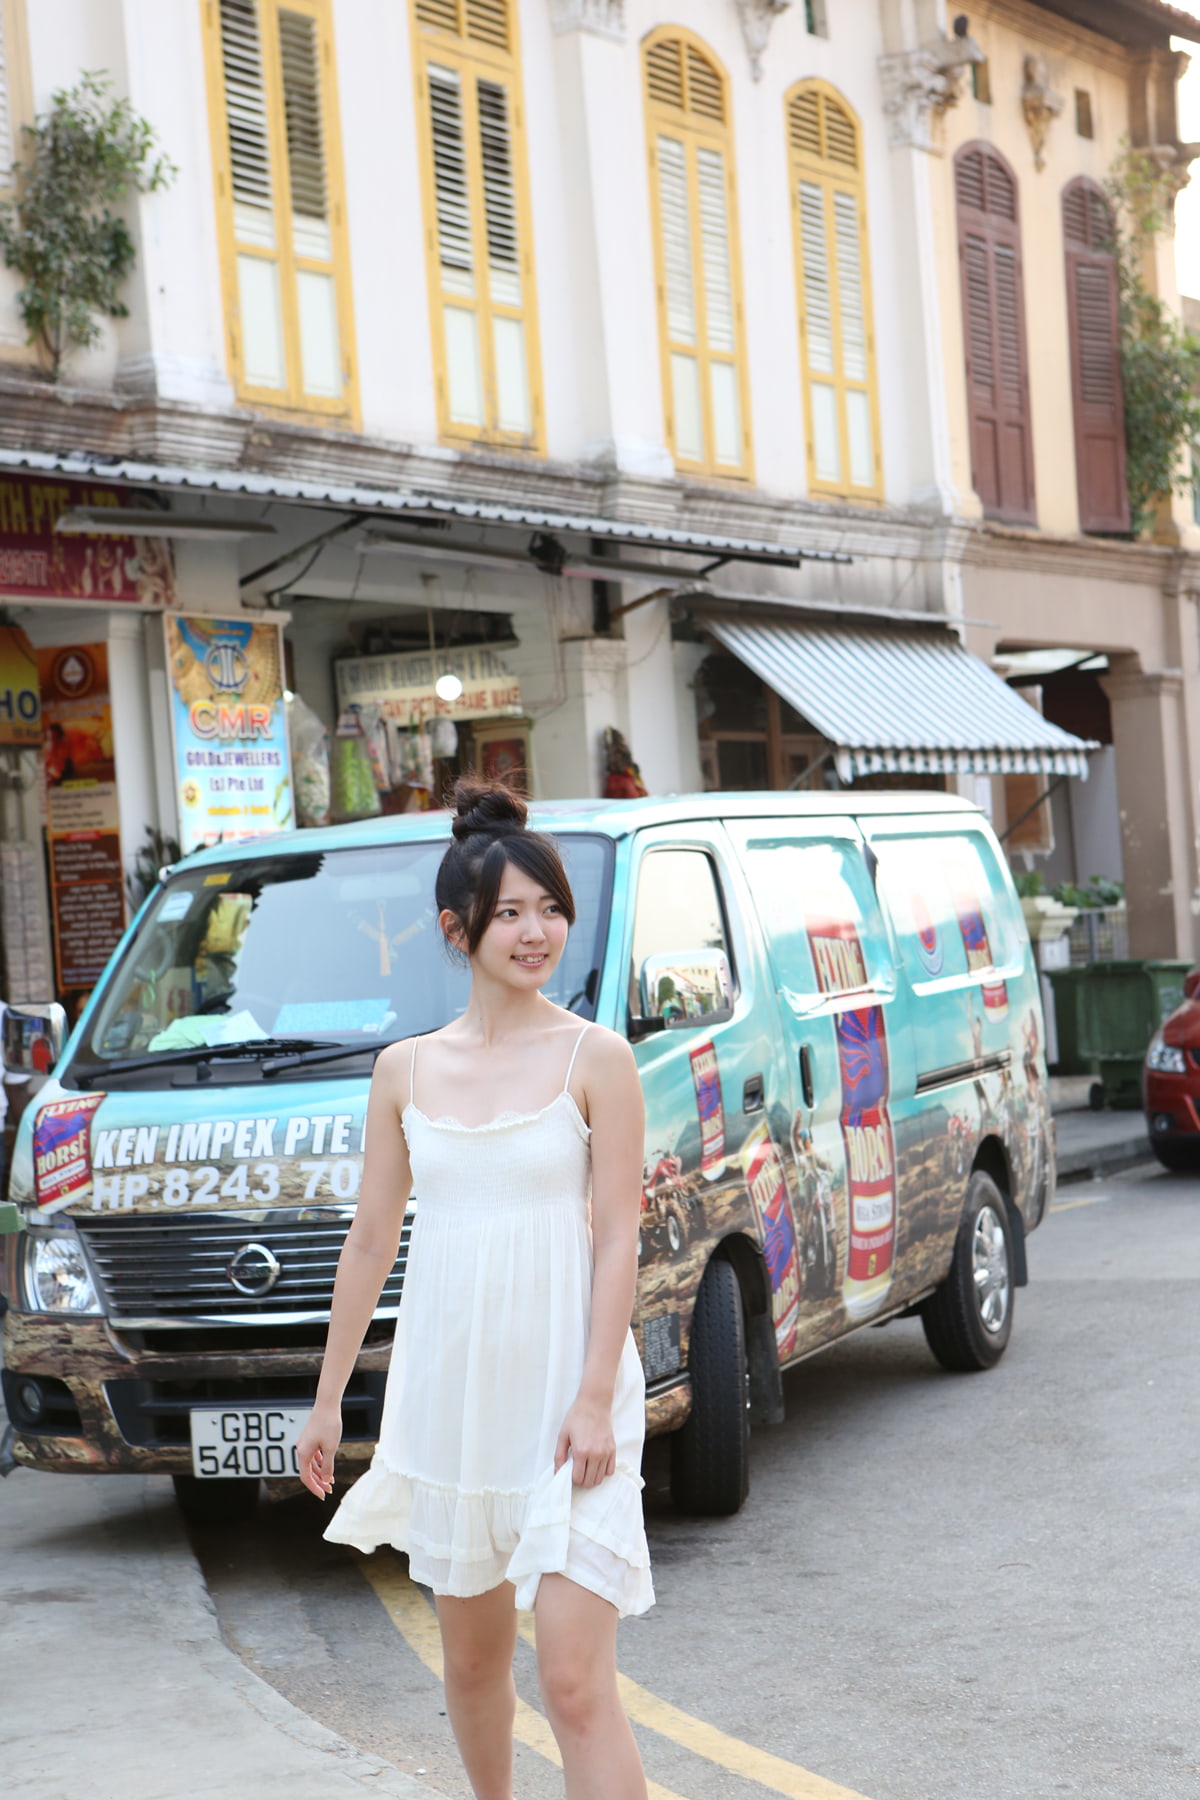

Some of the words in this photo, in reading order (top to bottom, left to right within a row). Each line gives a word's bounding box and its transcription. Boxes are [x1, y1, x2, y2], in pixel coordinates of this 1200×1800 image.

[189, 700, 272, 740] CMR
[248, 776, 264, 792] Ltd
[37, 1097, 101, 1129] FLYING
[37, 1129, 87, 1176] HORSE
[93, 1125, 160, 1169] KEN
[165, 1117, 278, 1163] IMPEX
[284, 1114, 353, 1157] PTE
[91, 1162, 281, 1211] HP:8243
[221, 1412, 285, 1442] GBC
